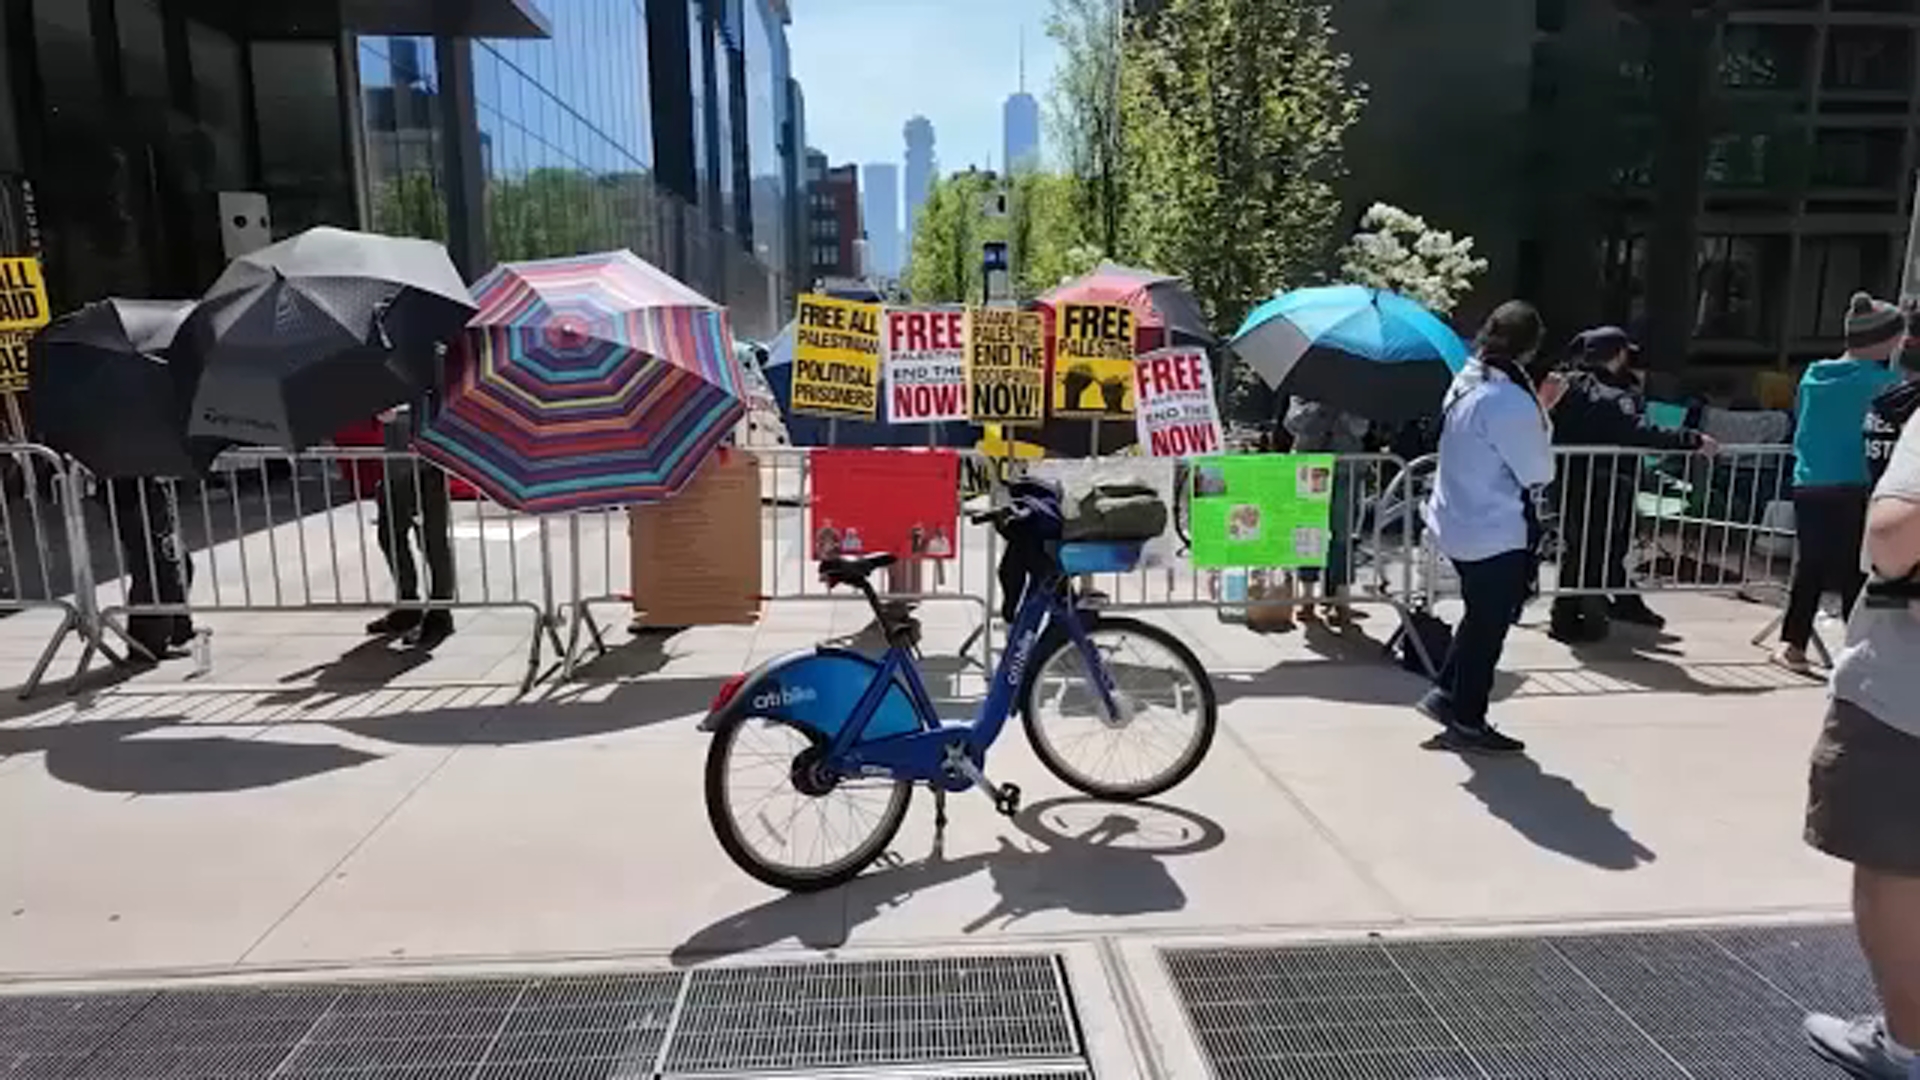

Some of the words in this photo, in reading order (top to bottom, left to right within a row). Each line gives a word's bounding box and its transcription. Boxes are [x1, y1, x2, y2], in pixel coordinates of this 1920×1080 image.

[0, 261, 36, 288] LL
[800, 303, 845, 330] FREE
[851, 309, 879, 335] ALL
[889, 312, 963, 350] FREE
[1065, 305, 1130, 342] FREE
[798, 329, 879, 354] PALESTINIAN
[1058, 338, 1133, 361] PALESTINE
[974, 344, 1011, 366] END
[1017, 344, 1043, 369] THE
[797, 360, 873, 387] POLITICAL
[893, 366, 928, 379] END
[932, 365, 965, 376] THE
[1136, 355, 1206, 398] FREE
[794, 383, 873, 408] PRISONERS
[893, 384, 967, 418] NOW!
[973, 383, 1040, 416] NOW!
[1146, 407, 1179, 423] END
[1181, 405, 1210, 416] THE
[1151, 422, 1219, 457] NOW!
